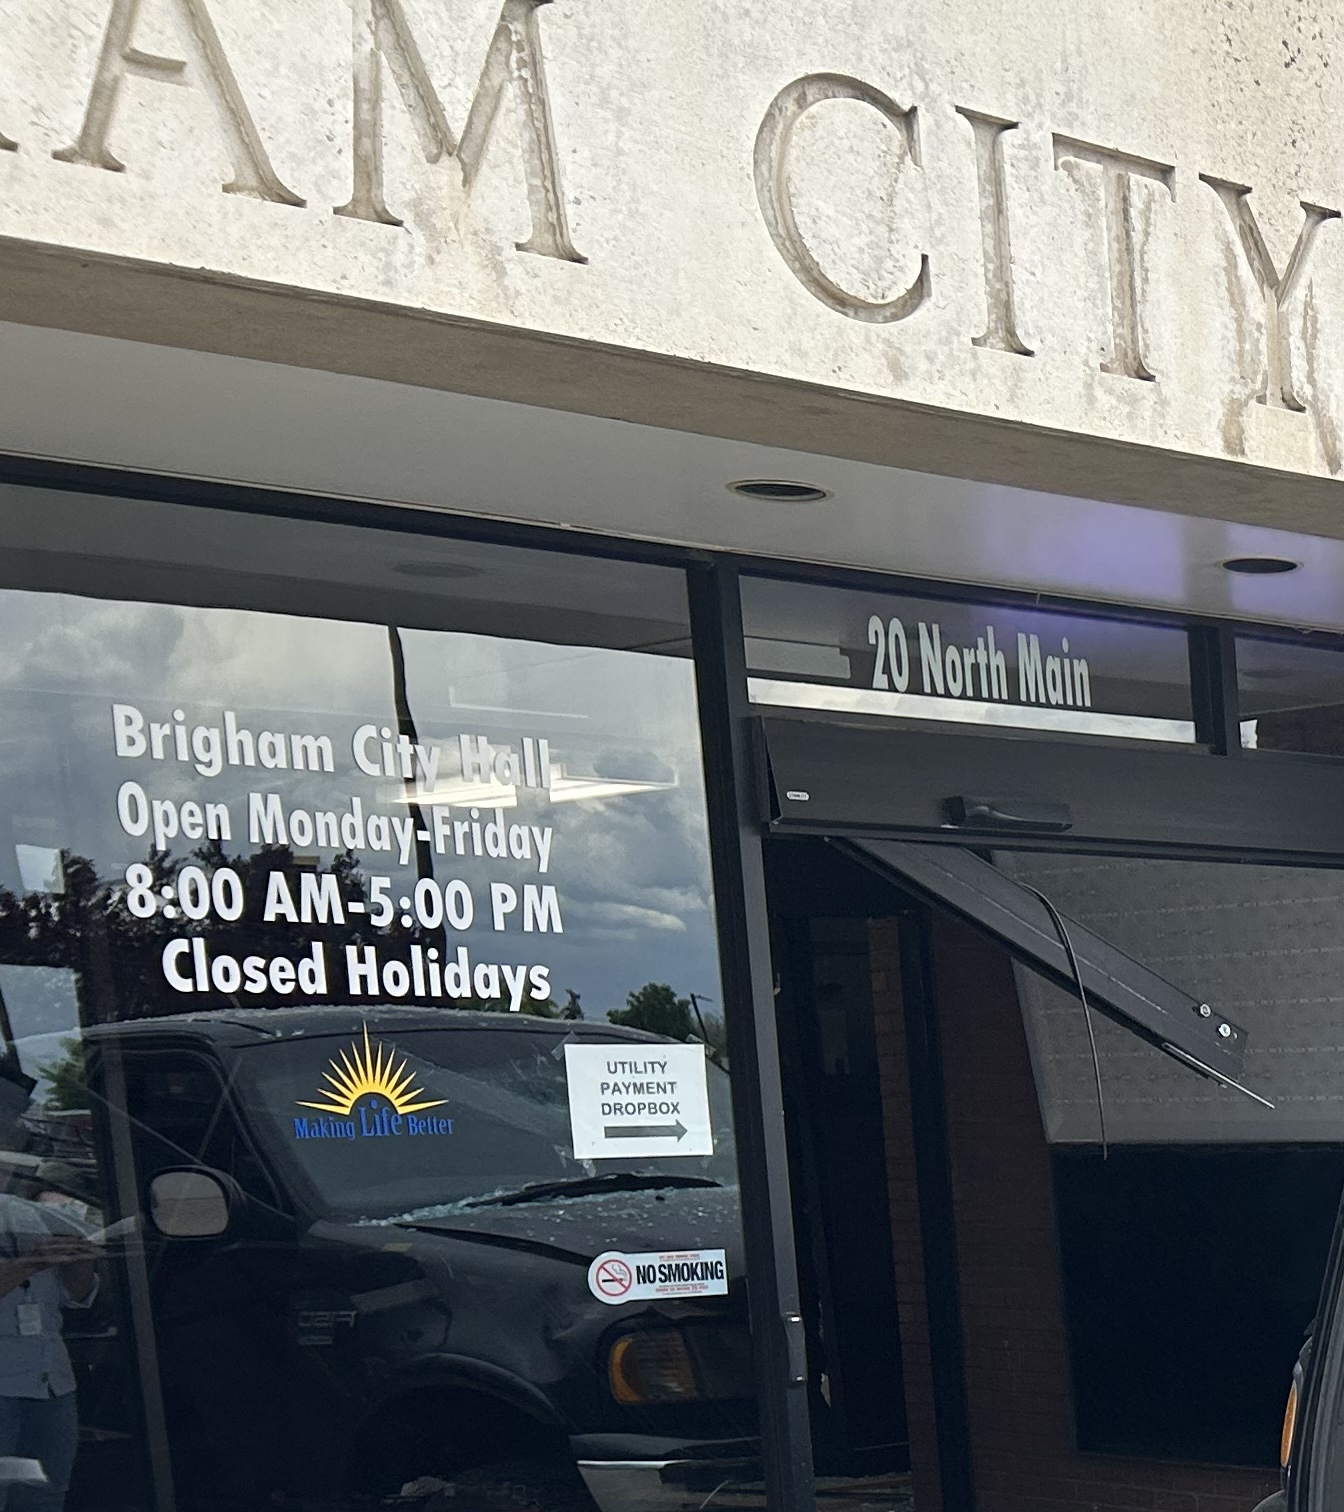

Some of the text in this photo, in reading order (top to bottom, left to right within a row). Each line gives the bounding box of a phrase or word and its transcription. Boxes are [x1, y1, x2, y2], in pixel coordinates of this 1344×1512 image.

[0, 0, 588, 264] AM
[753, 72, 1341, 413] CITY
[867, 614, 1092, 708] 20 North Main
[112, 703, 551, 792] Brigham City Hall
[117, 781, 553, 873] Open Monday-Friday
[125, 862, 564, 934] 8:00 AM-5:00 PM
[162, 938, 551, 1012] Closed Holidays
[600, 1081, 677, 1096] PAYMENT
[607, 1061, 667, 1075] UTILITY
[293, 1099, 454, 1140] Making Life Better
[601, 1102, 680, 1116] DROPBOX
[636, 1260, 725, 1285] NO SMOKING
